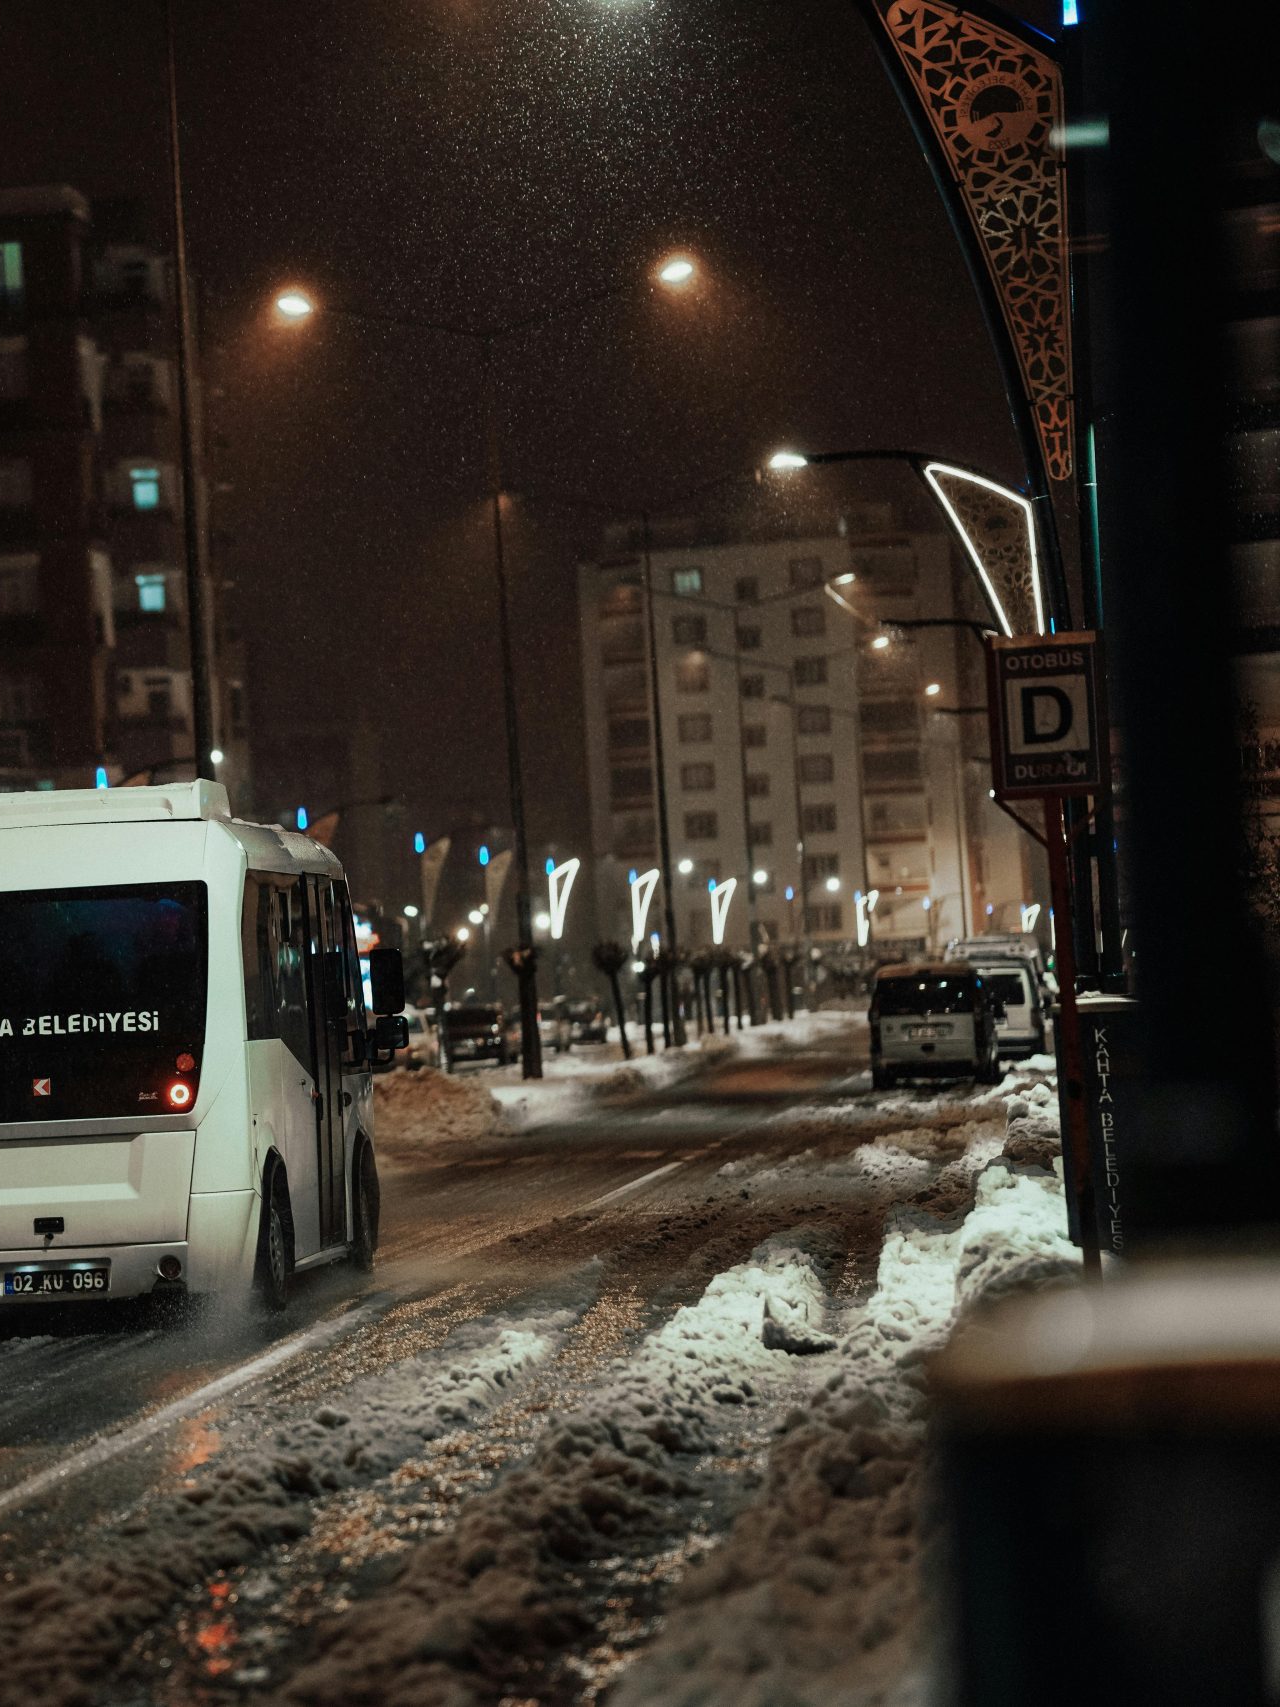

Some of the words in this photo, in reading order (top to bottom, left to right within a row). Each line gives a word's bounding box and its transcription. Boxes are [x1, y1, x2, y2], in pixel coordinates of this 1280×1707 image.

[1021, 686, 1073, 744] D
[13, 1274, 34, 1292] 02
[73, 1271, 105, 1290] 096
